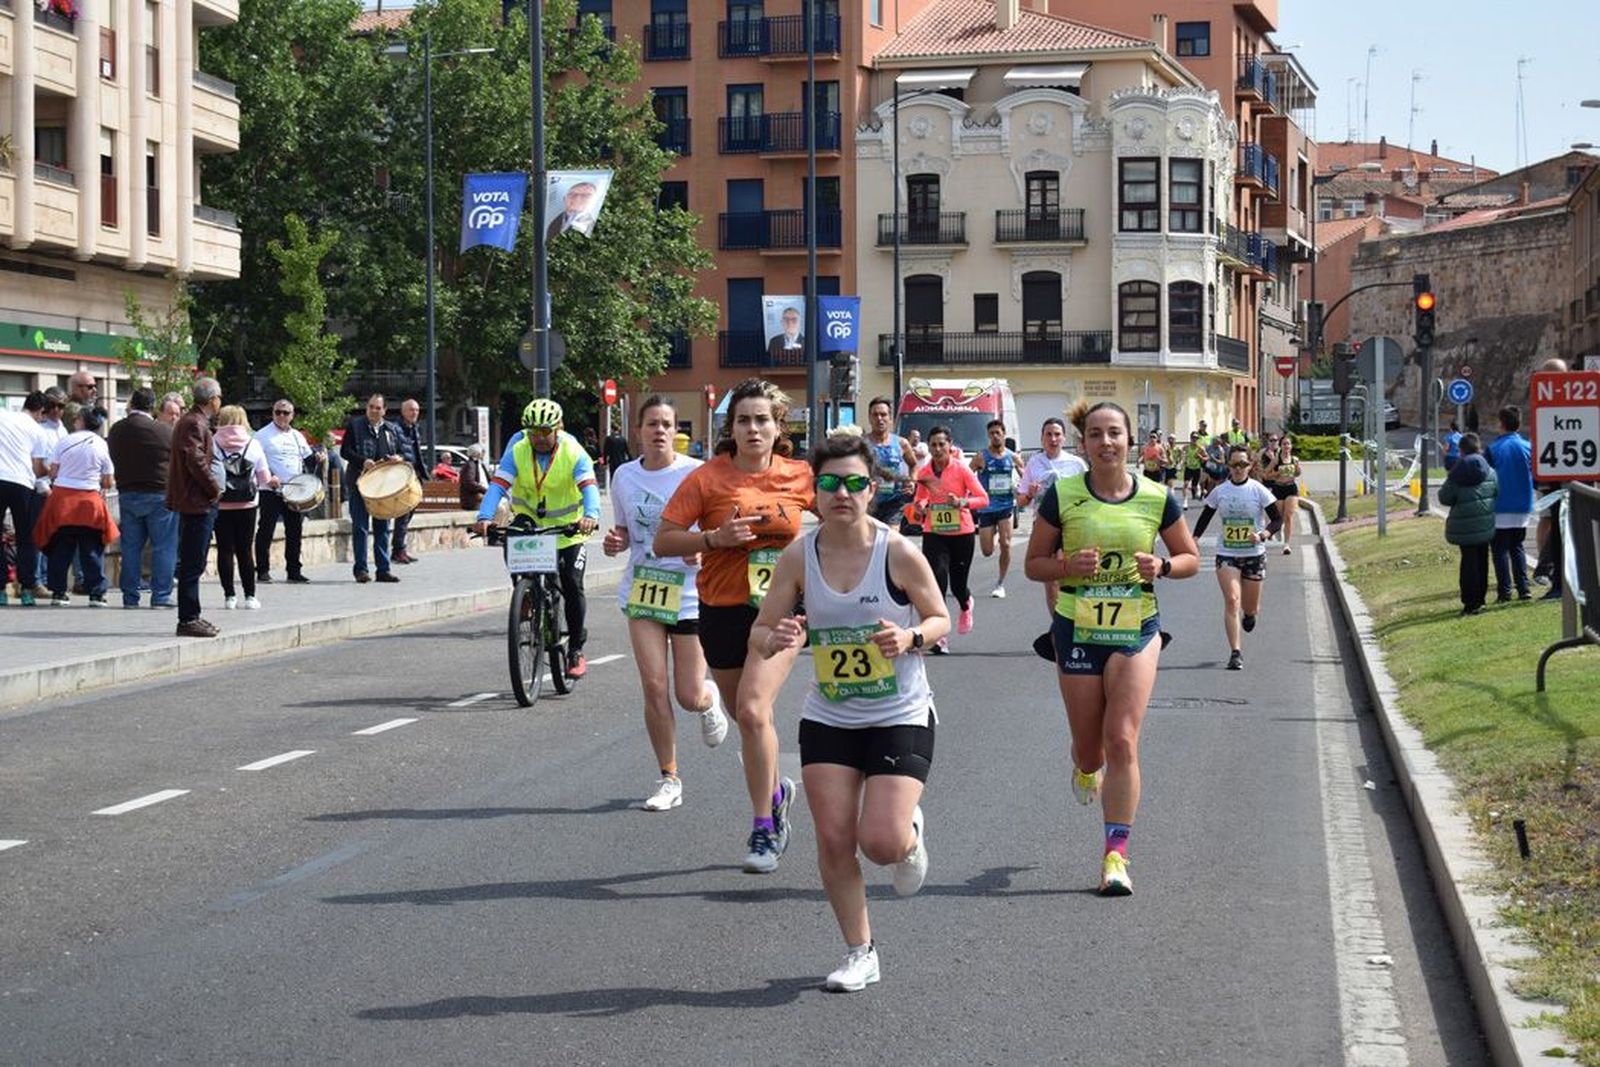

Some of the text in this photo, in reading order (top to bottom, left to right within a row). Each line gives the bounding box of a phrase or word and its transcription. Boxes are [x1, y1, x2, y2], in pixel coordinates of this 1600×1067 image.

[473, 191, 510, 203] VOTA
[826, 310, 853, 320] VOTA
[1537, 381, 1598, 401] N-122
[1553, 415, 1583, 431] km
[1540, 440, 1598, 468] 459
[936, 511, 952, 524] 40
[1226, 526, 1250, 540] 217
[639, 583, 669, 606] 111
[860, 596, 879, 604] FILA
[1093, 602, 1123, 626] 17
[831, 649, 872, 678] 23
